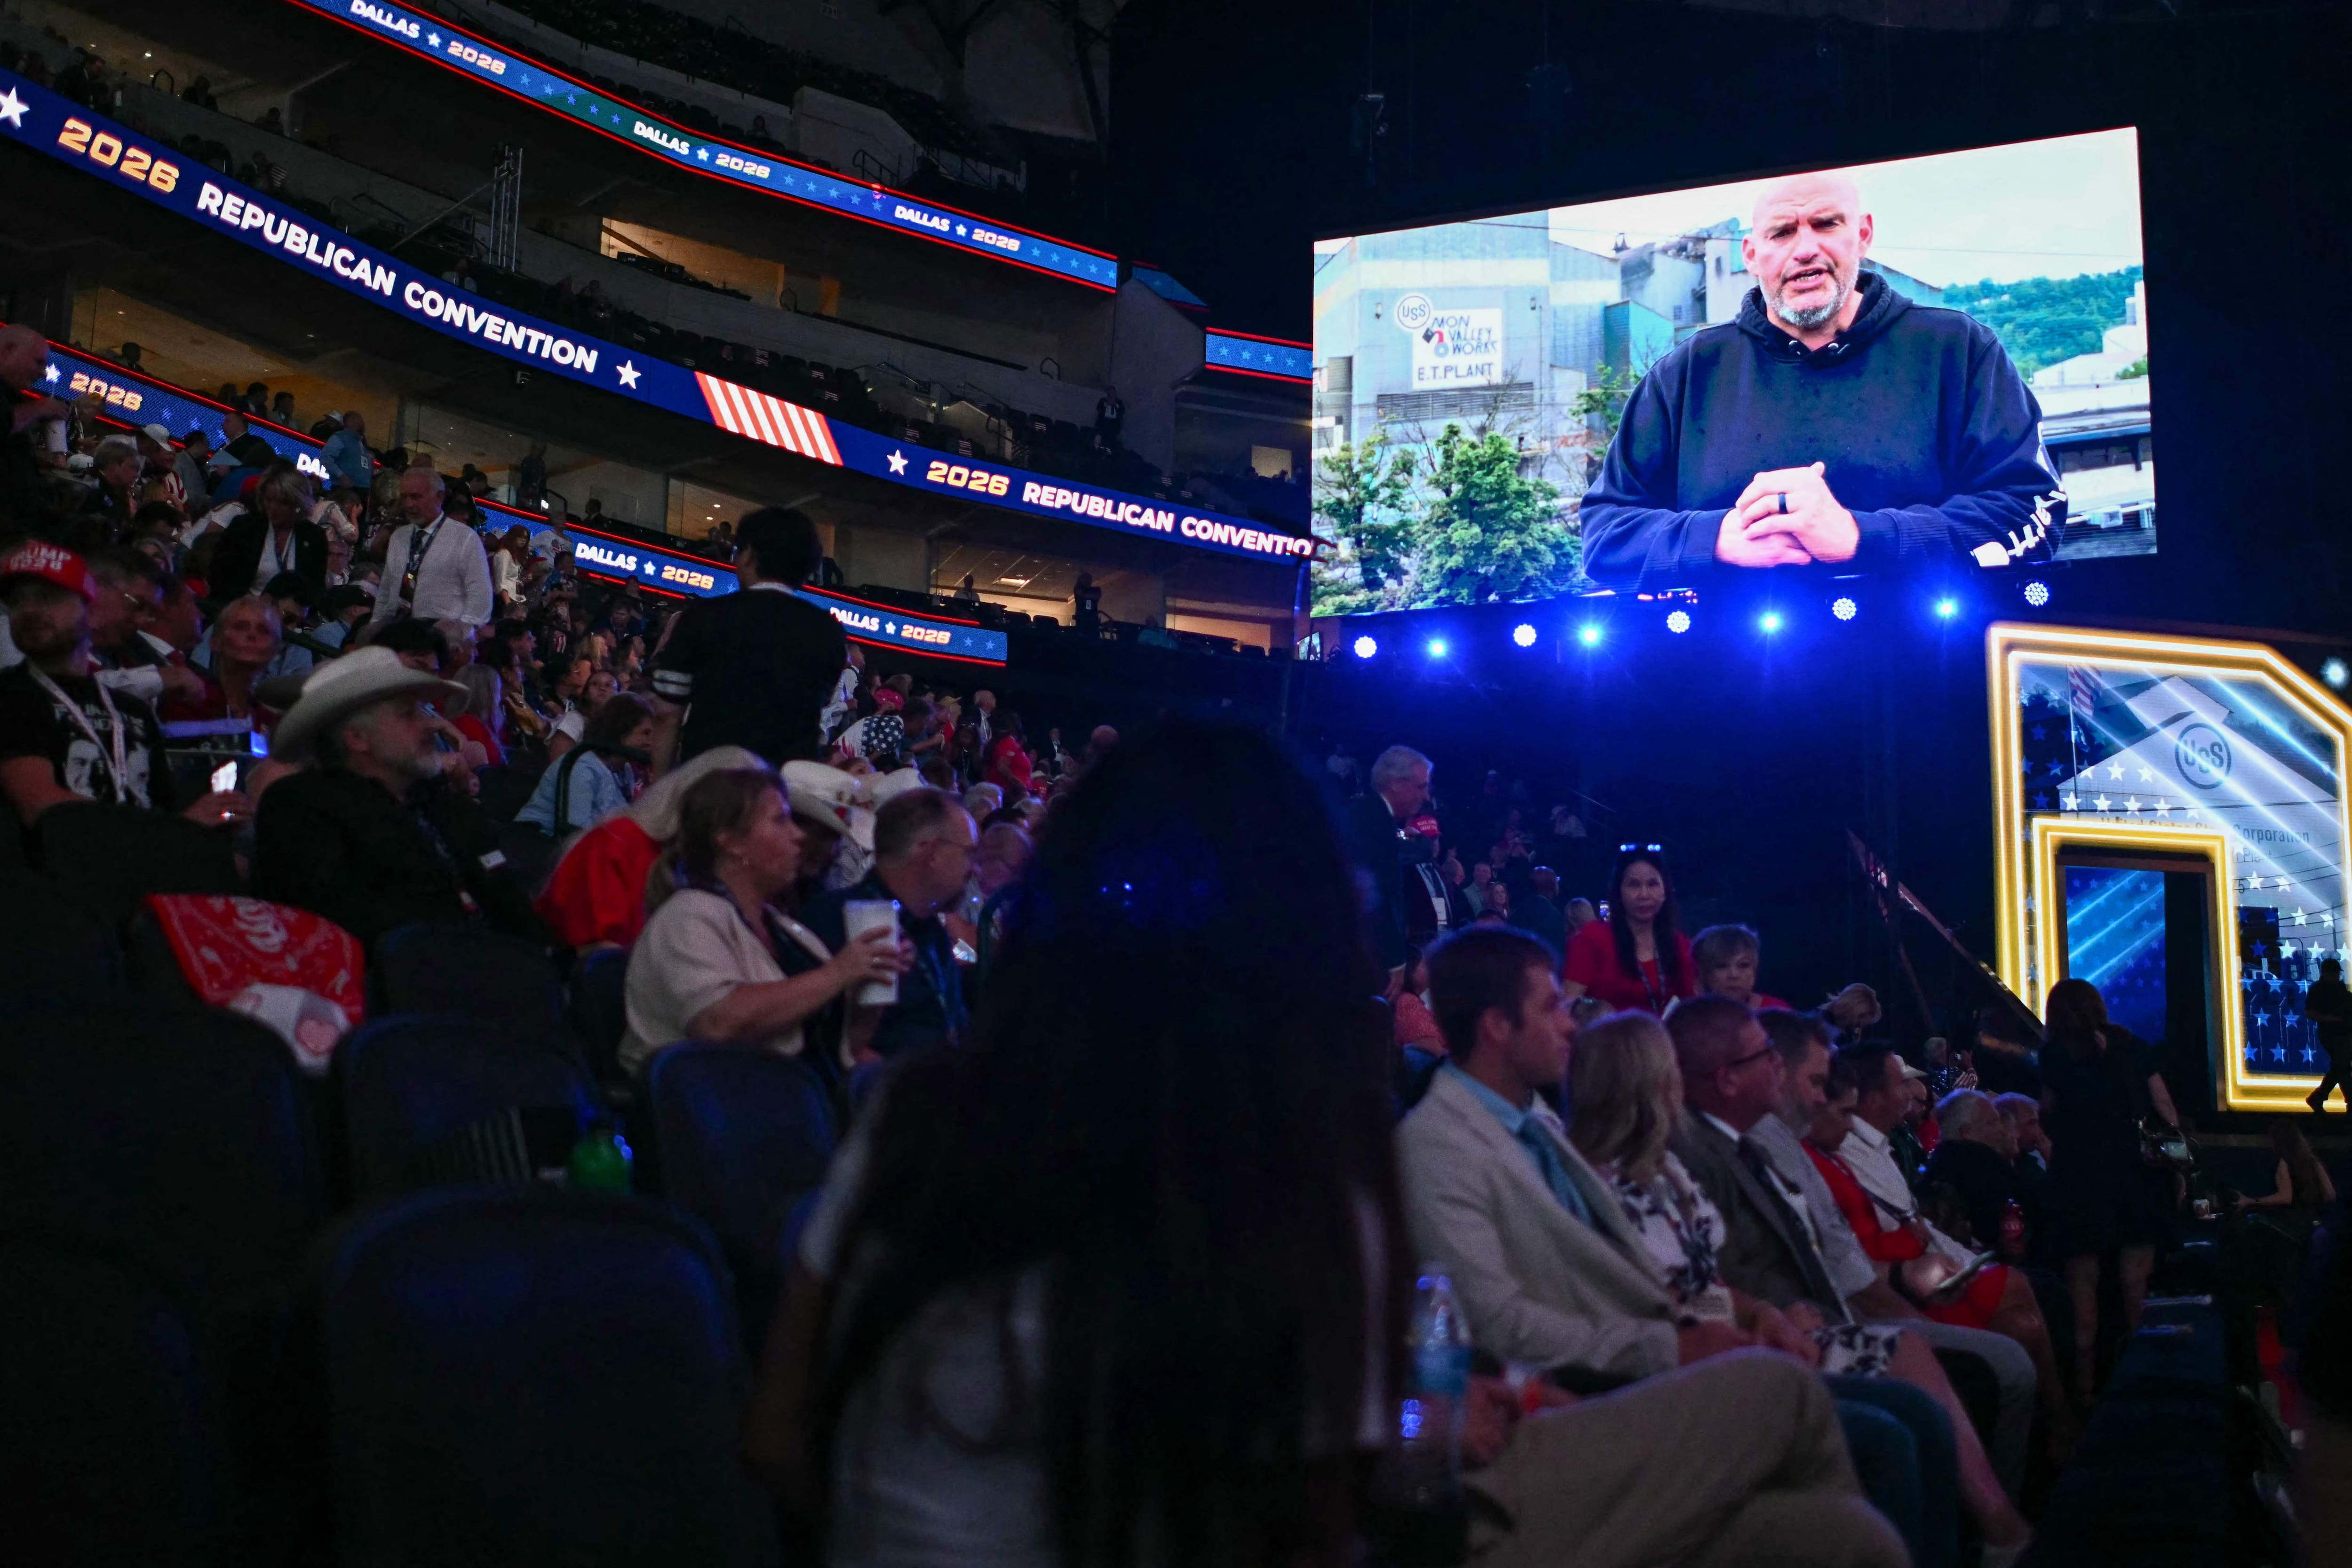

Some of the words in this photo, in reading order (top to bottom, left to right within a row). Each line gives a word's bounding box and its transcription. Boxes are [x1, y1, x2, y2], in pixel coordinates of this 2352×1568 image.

[350, 0, 420, 38] DALLAS
[447, 40, 506, 75] 2026
[634, 121, 690, 155] DALLAS
[715, 153, 771, 178] 2026
[58, 119, 179, 192] 2026
[197, 182, 396, 295] REPUBLICAN
[405, 282, 598, 373] CONVENTION
[894, 205, 950, 231] DALLAS
[972, 228, 1020, 251] 2026
[1431, 316, 1470, 327] MON
[1449, 328, 1492, 341] VALLEY
[69, 372, 143, 411] 2026
[296, 453, 330, 479] DAL
[926, 461, 1009, 496] 2026
[1023, 482, 1175, 532] REPUBLICAN
[1181, 517, 1314, 556] CONVENTIO
[575, 542, 637, 571] DALLAS
[661, 565, 714, 589] 2026
[830, 607, 880, 631] DALLAS
[901, 624, 951, 644] 2026
[2183, 740, 2224, 774] USS
